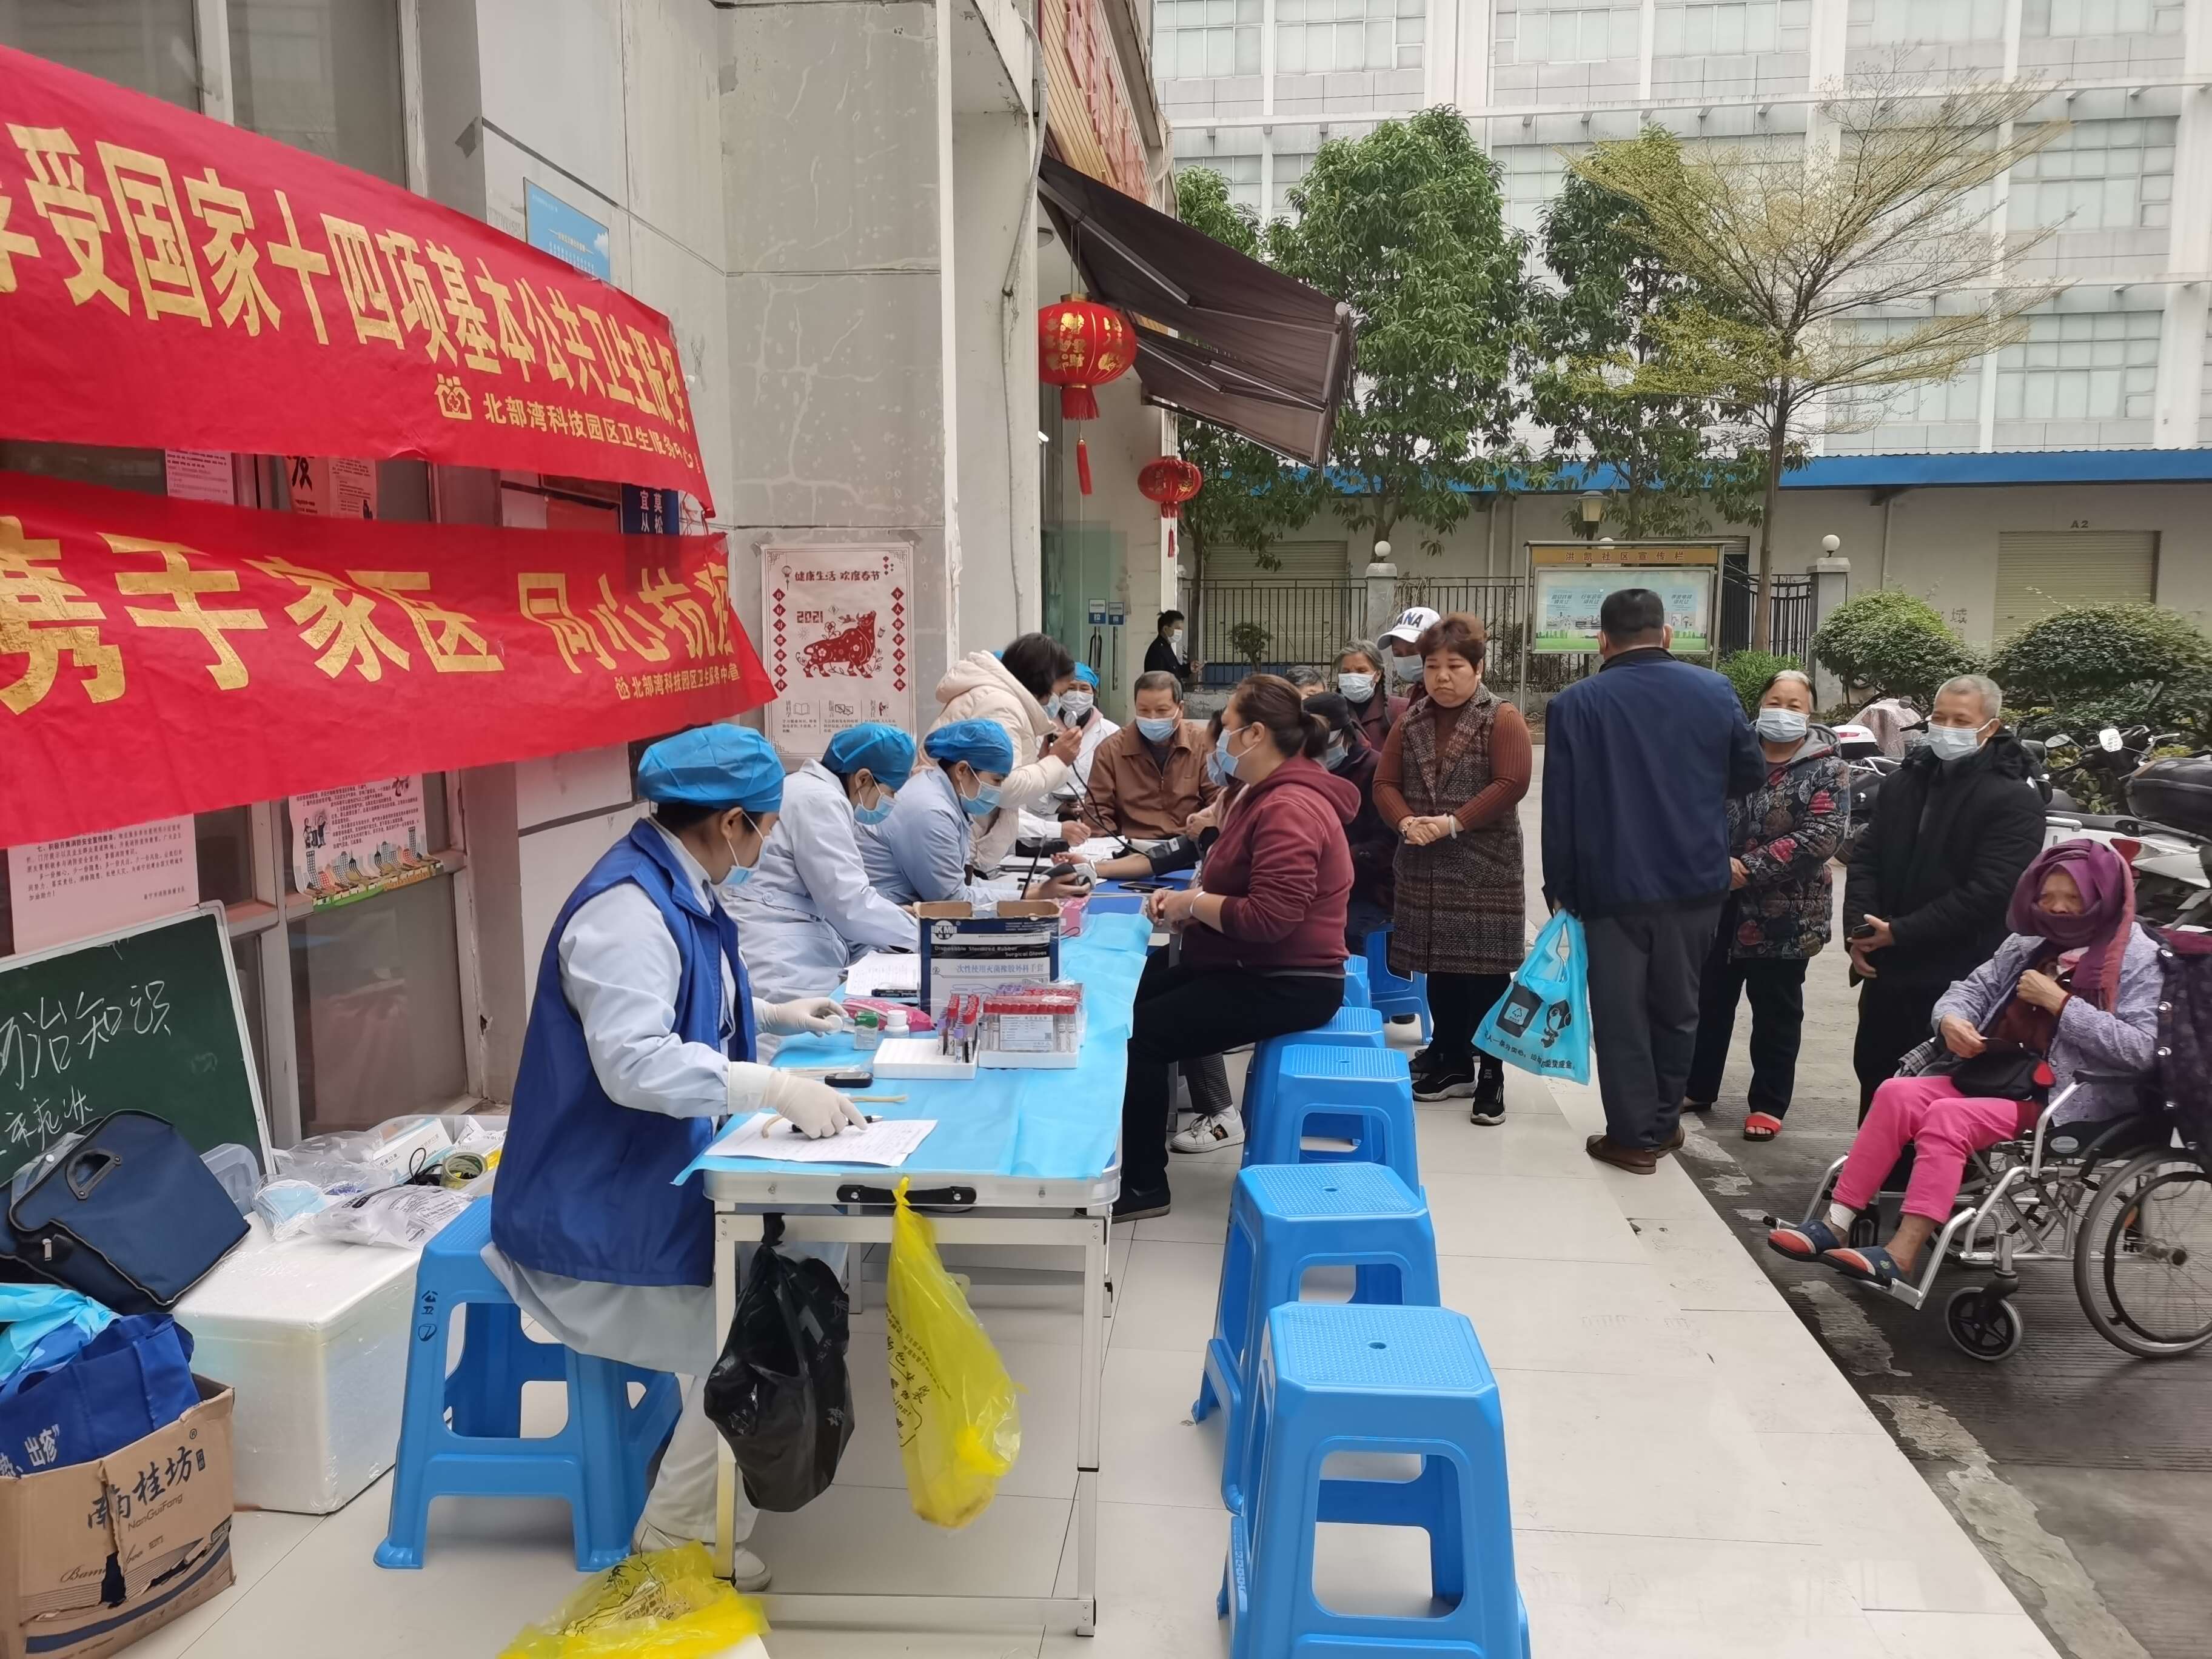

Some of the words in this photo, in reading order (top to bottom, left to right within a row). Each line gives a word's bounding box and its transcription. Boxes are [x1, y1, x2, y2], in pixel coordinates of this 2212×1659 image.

[2070, 520, 2089, 528] A2
[1565, 551, 1685, 561] 洪凯社区宣传栏
[794, 571, 837, 581] 健康生活
[840, 571, 880, 581] 欢度春节
[796, 611, 823, 623] 2021
[1394, 612, 1424, 628] ANA
